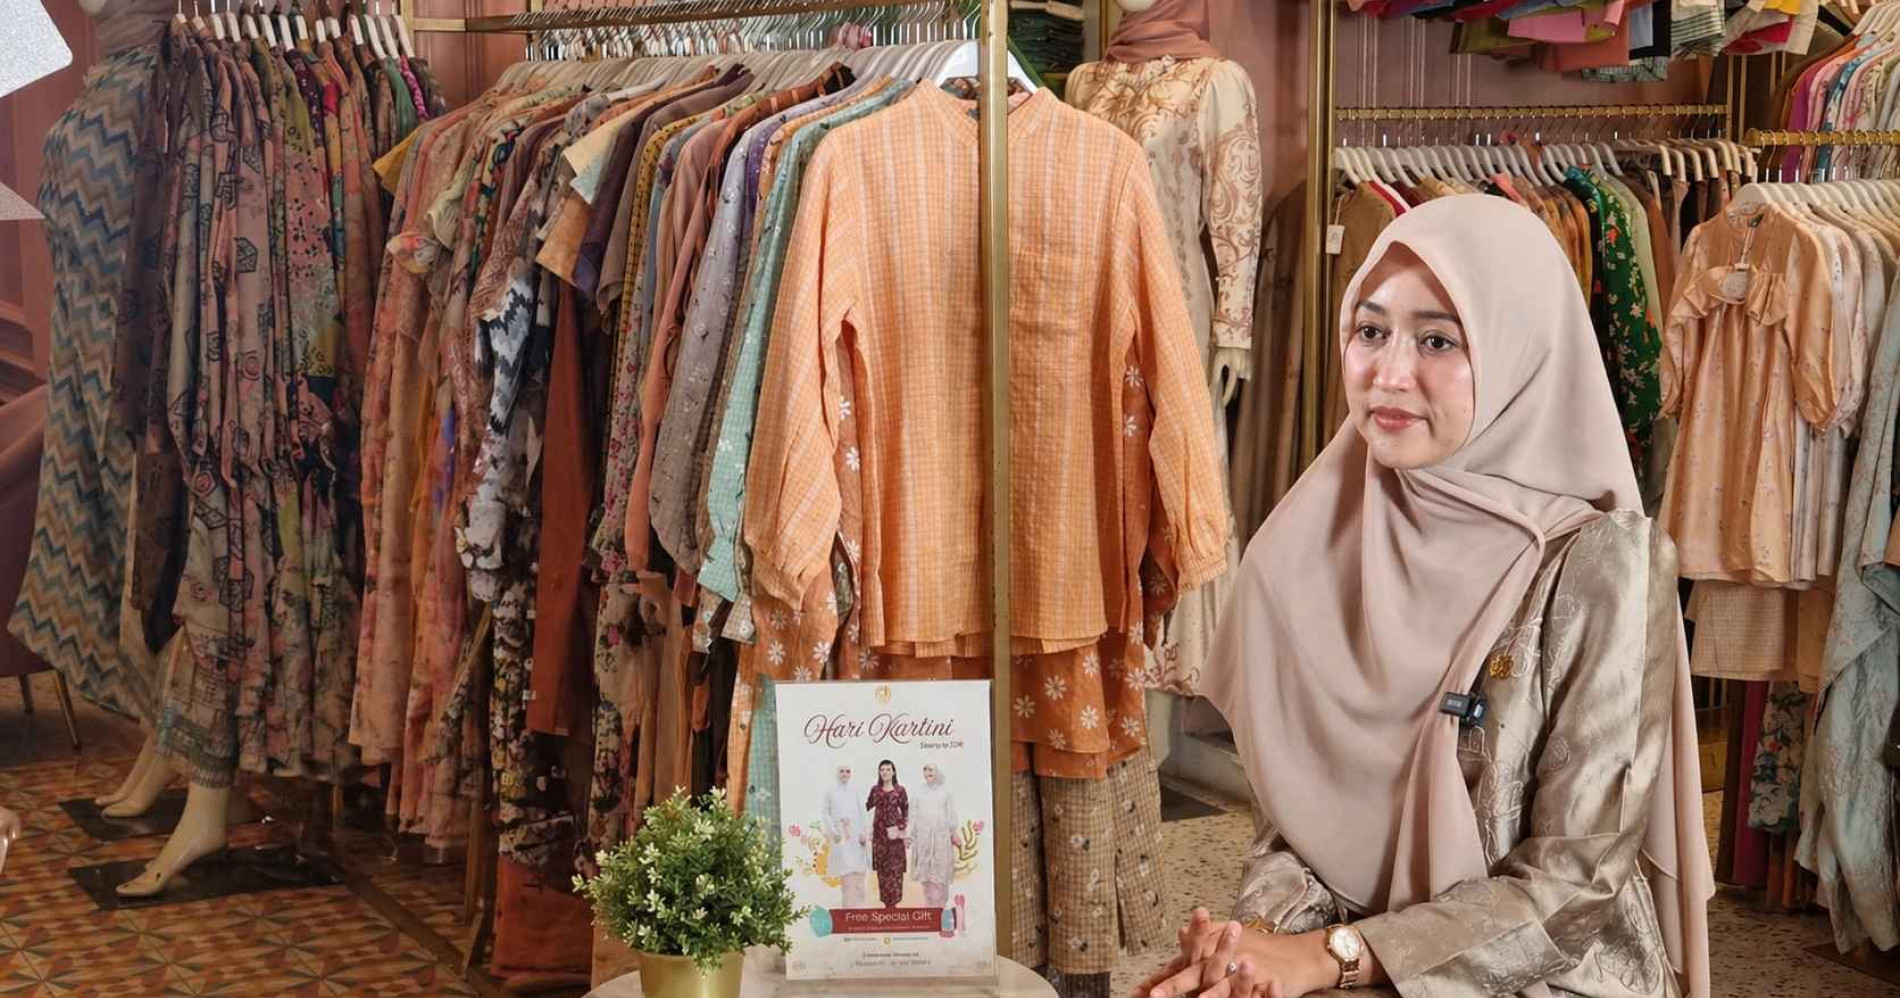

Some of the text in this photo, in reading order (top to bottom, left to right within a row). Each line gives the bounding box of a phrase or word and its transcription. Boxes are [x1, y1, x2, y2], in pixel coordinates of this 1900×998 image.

[804, 713, 955, 749] Hari Kartini
[845, 910, 932, 924] Free Special Gift
